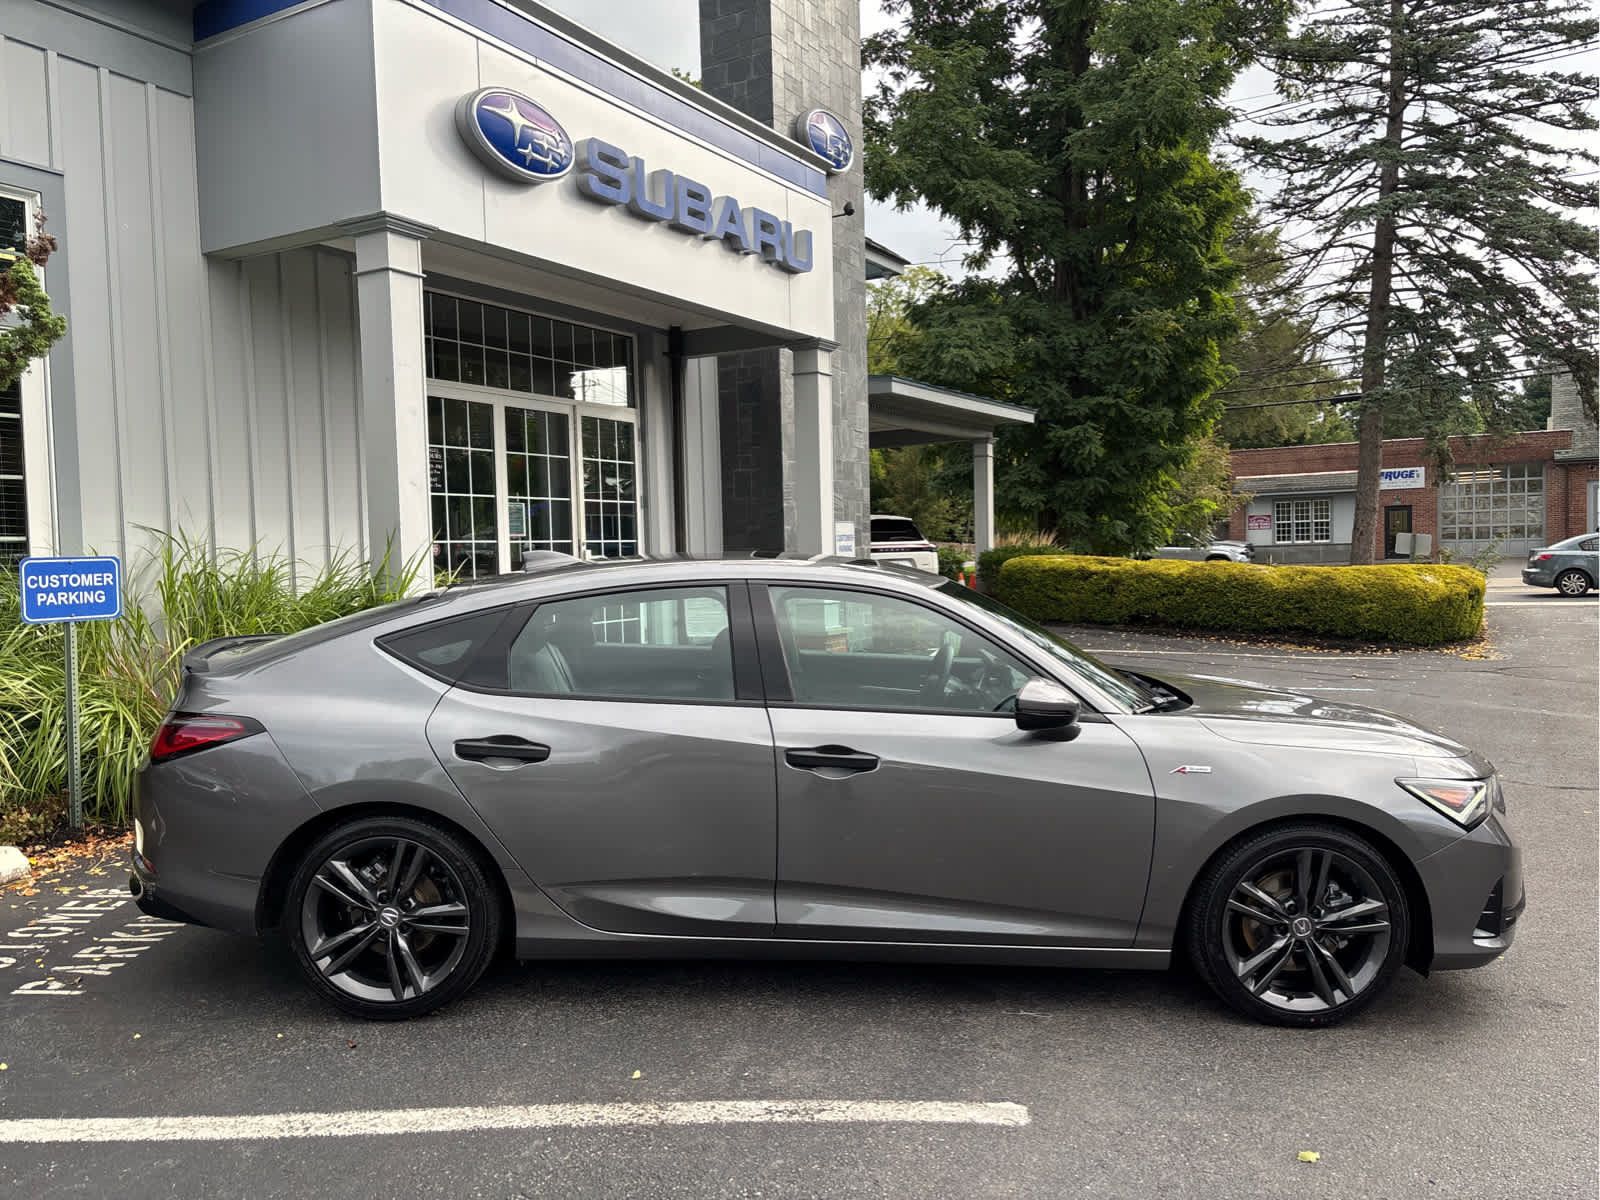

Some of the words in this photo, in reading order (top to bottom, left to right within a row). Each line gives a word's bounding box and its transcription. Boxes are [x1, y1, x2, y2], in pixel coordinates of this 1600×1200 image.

[576, 137, 813, 274] SUBARU
[26, 573, 114, 589] CUSTOMER
[37, 590, 106, 606] PARKING
